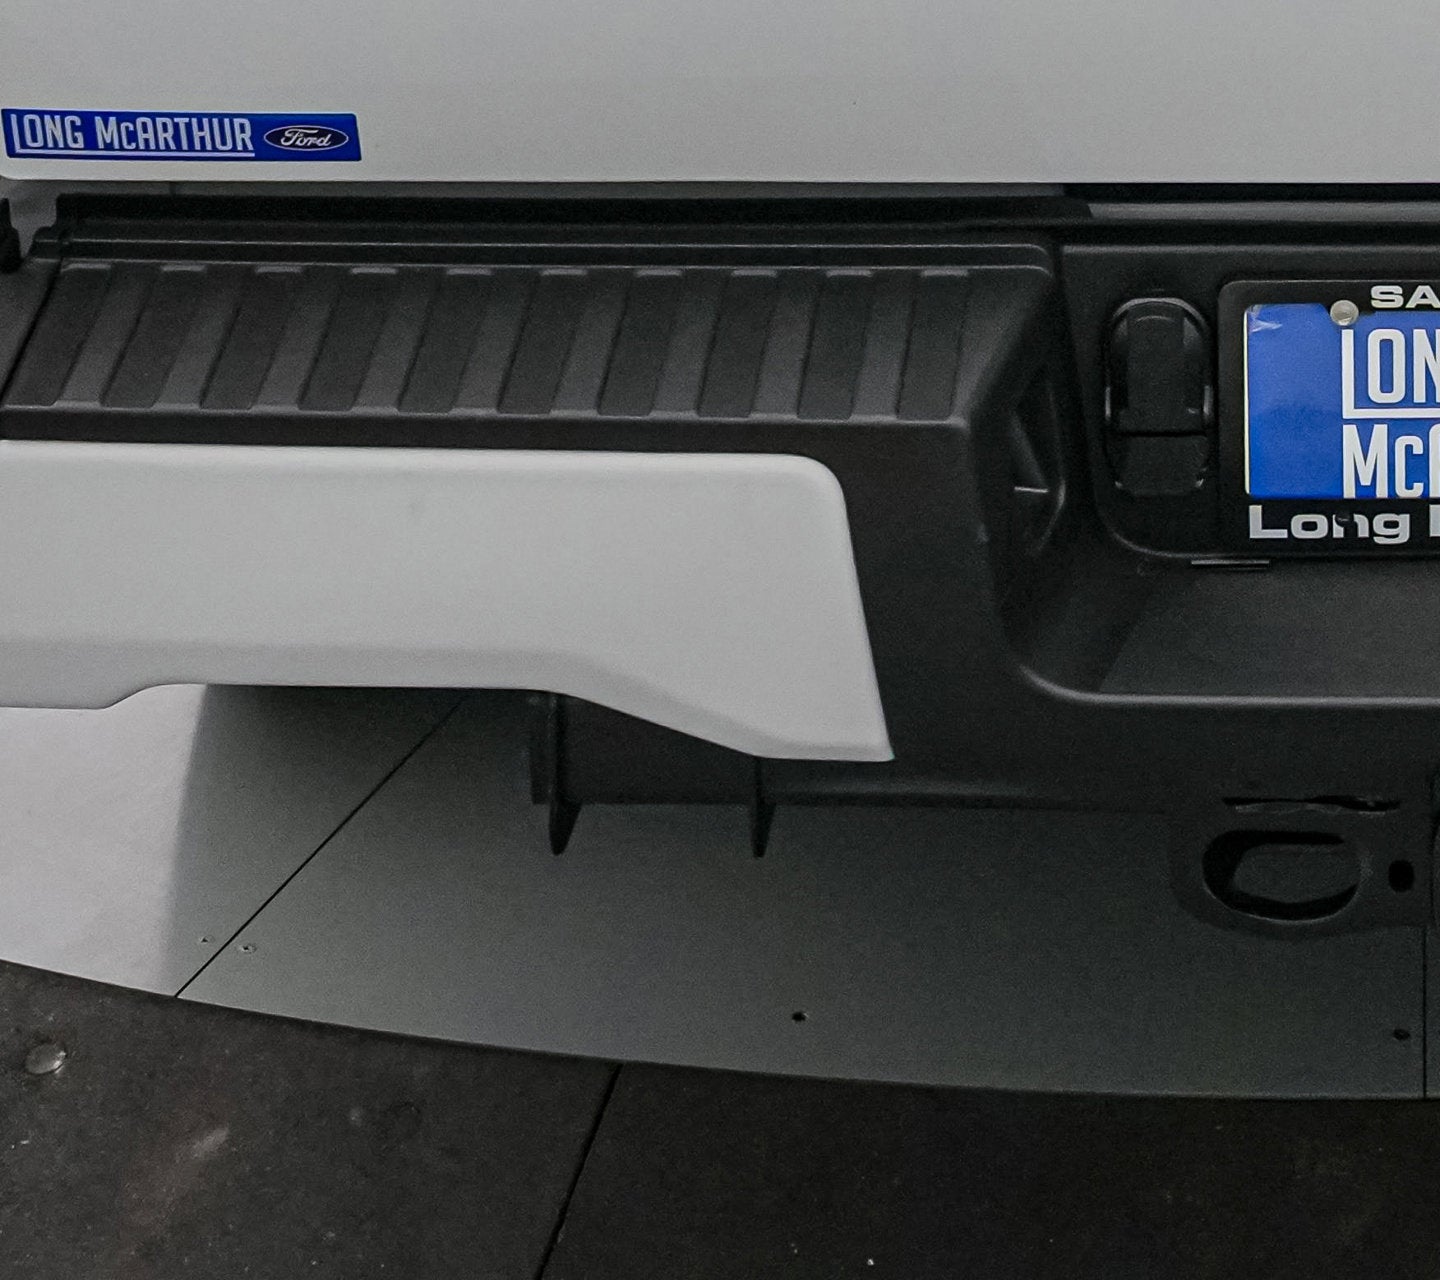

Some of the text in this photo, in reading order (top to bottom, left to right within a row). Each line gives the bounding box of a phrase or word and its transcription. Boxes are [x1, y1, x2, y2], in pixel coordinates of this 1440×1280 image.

[10, 113, 332, 153] LONG McARTHUR Ford
[1248, 504, 1411, 545] Long
